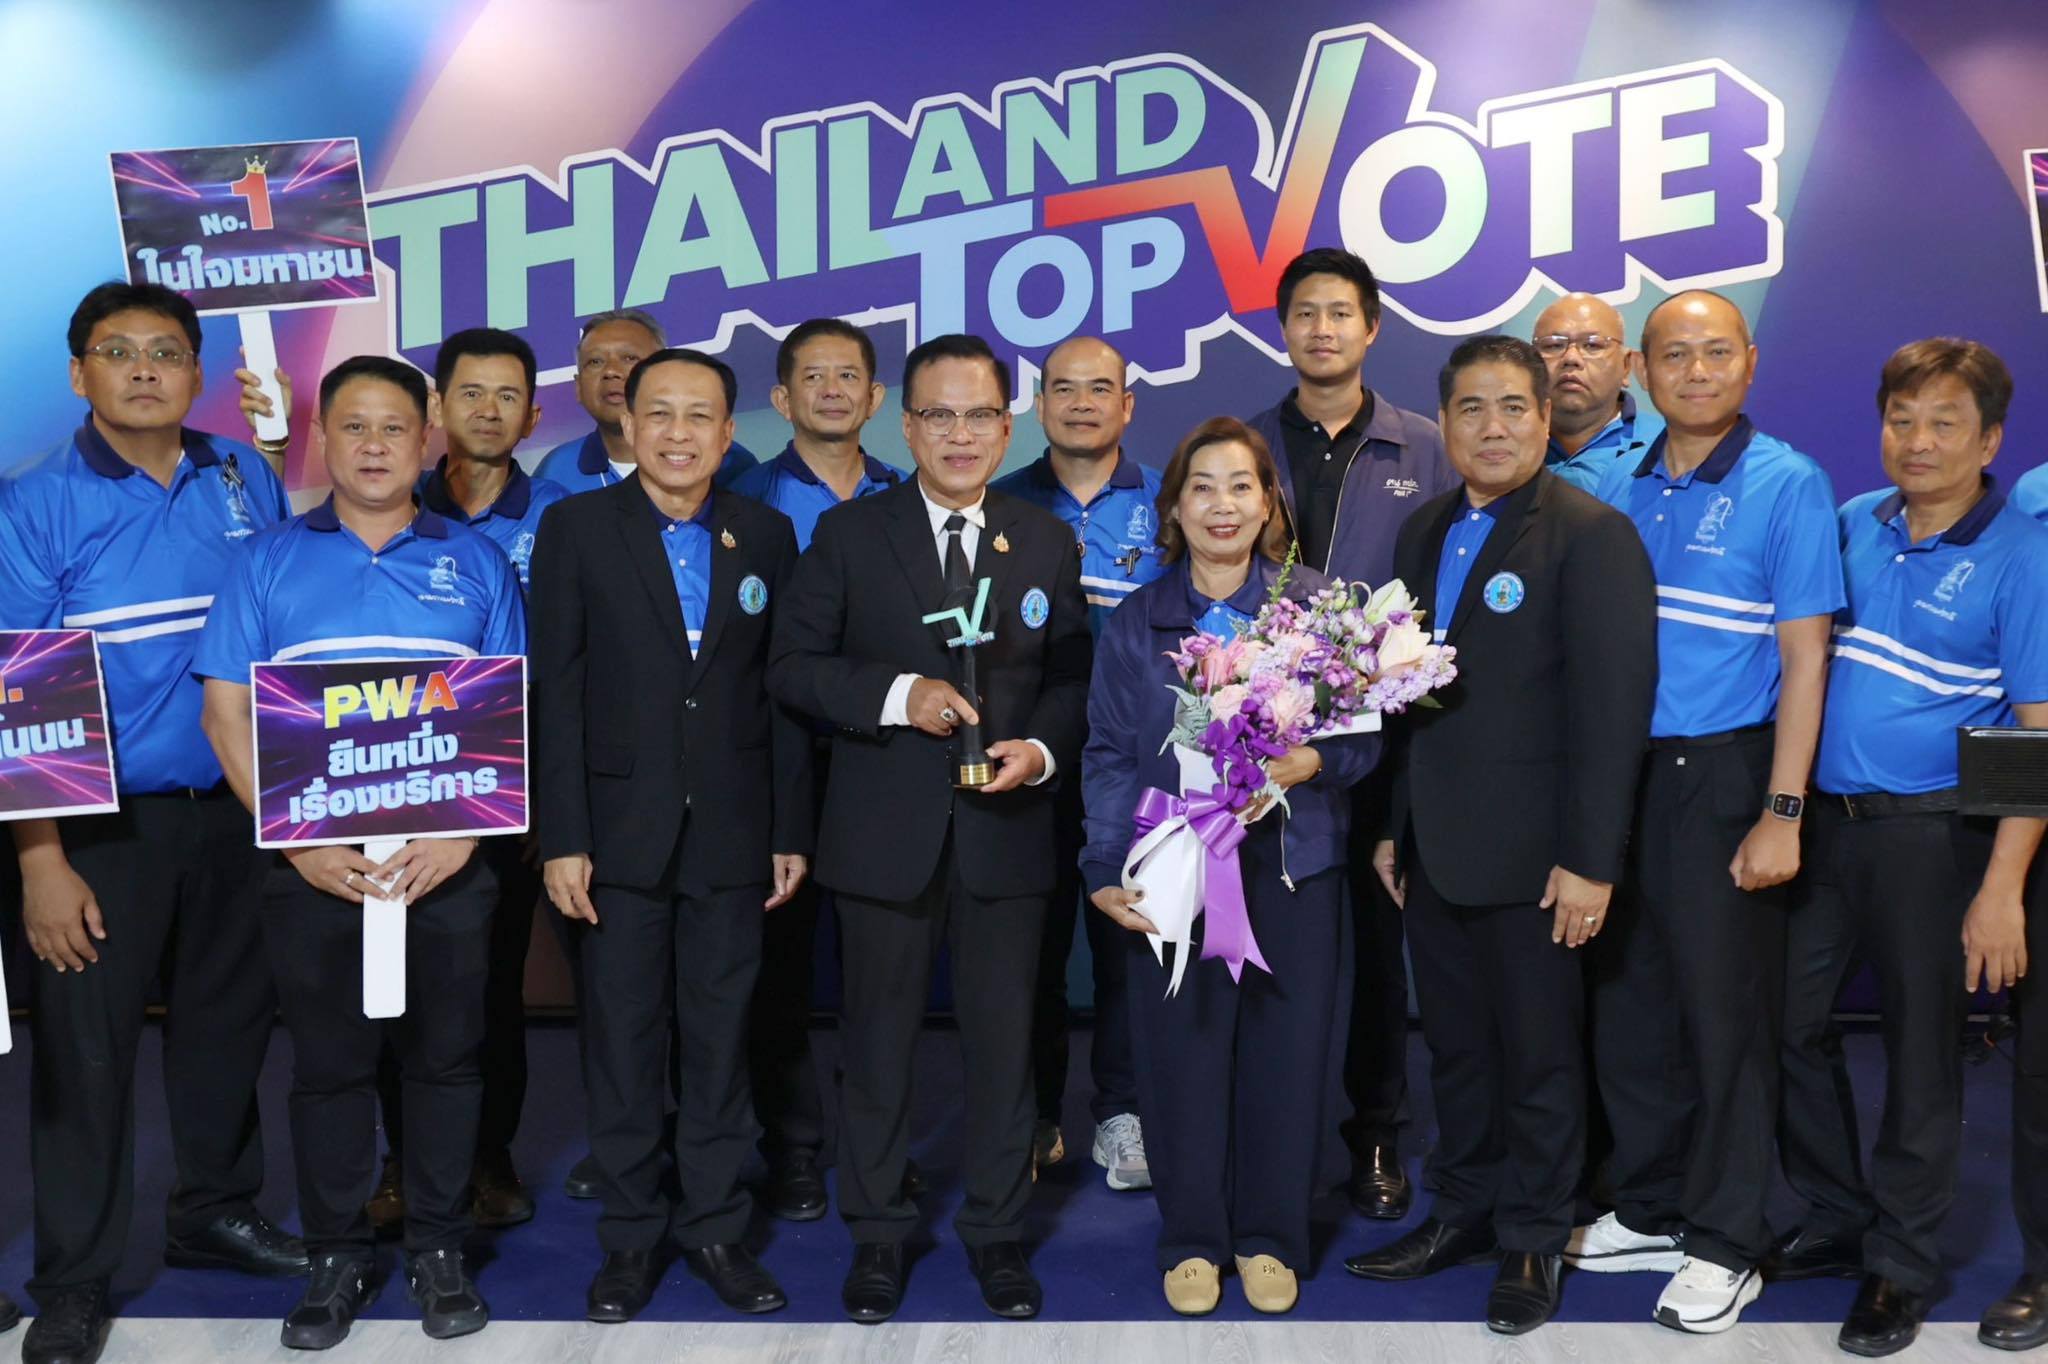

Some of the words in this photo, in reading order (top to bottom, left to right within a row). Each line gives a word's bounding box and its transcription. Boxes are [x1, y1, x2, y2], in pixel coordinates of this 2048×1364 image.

[364, 64, 1206, 350] THAILAND
[883, 198, 1186, 348] TOP
[1045, 36, 1717, 317] VOTE
[136, 245, 365, 290] ในใจมหาชน
[323, 671, 459, 729] PWA
[0, 717, 86, 760] นนน
[328, 721, 458, 777] ยืนหนึ่ง
[289, 766, 498, 824] เรื่องบริการ
